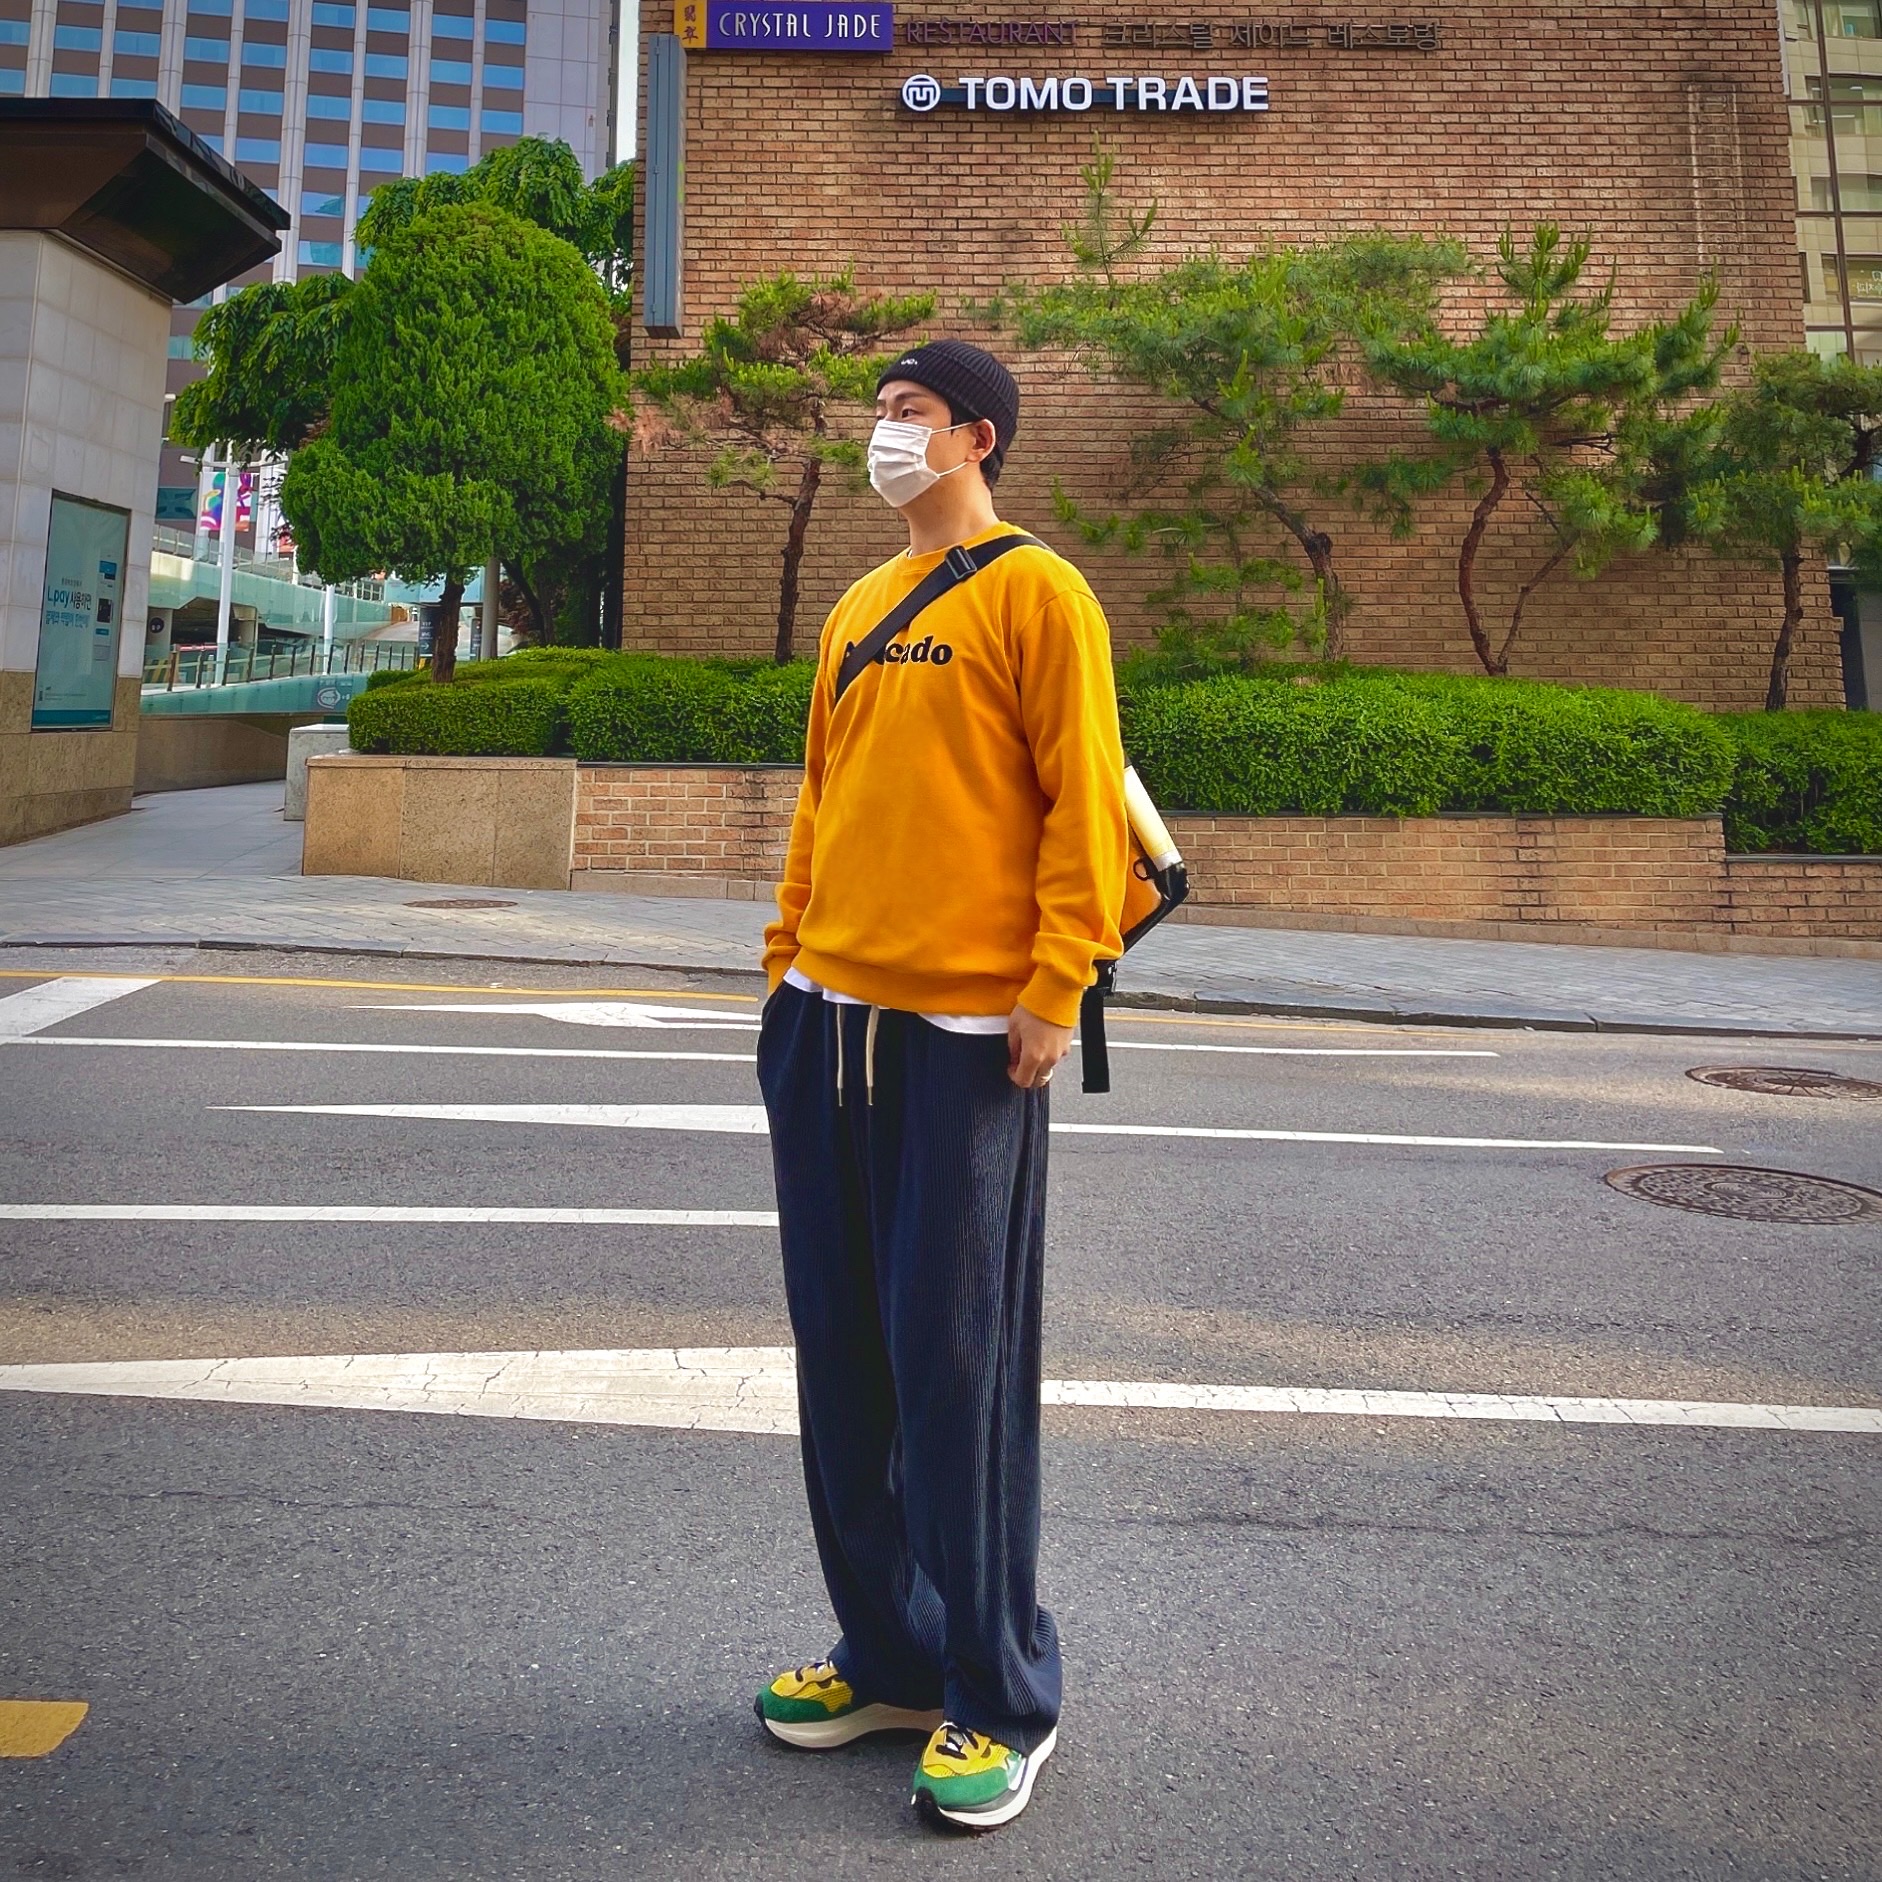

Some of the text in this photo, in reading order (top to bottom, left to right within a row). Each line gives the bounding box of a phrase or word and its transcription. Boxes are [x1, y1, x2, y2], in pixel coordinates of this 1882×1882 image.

[719, 12, 881, 38] CRYSTAL JADE
[906, 19, 1079, 45] RESTAURANT
[1101, 22, 1214, 49] 크리스탈
[959, 76, 1269, 111] TOMO TRADE
